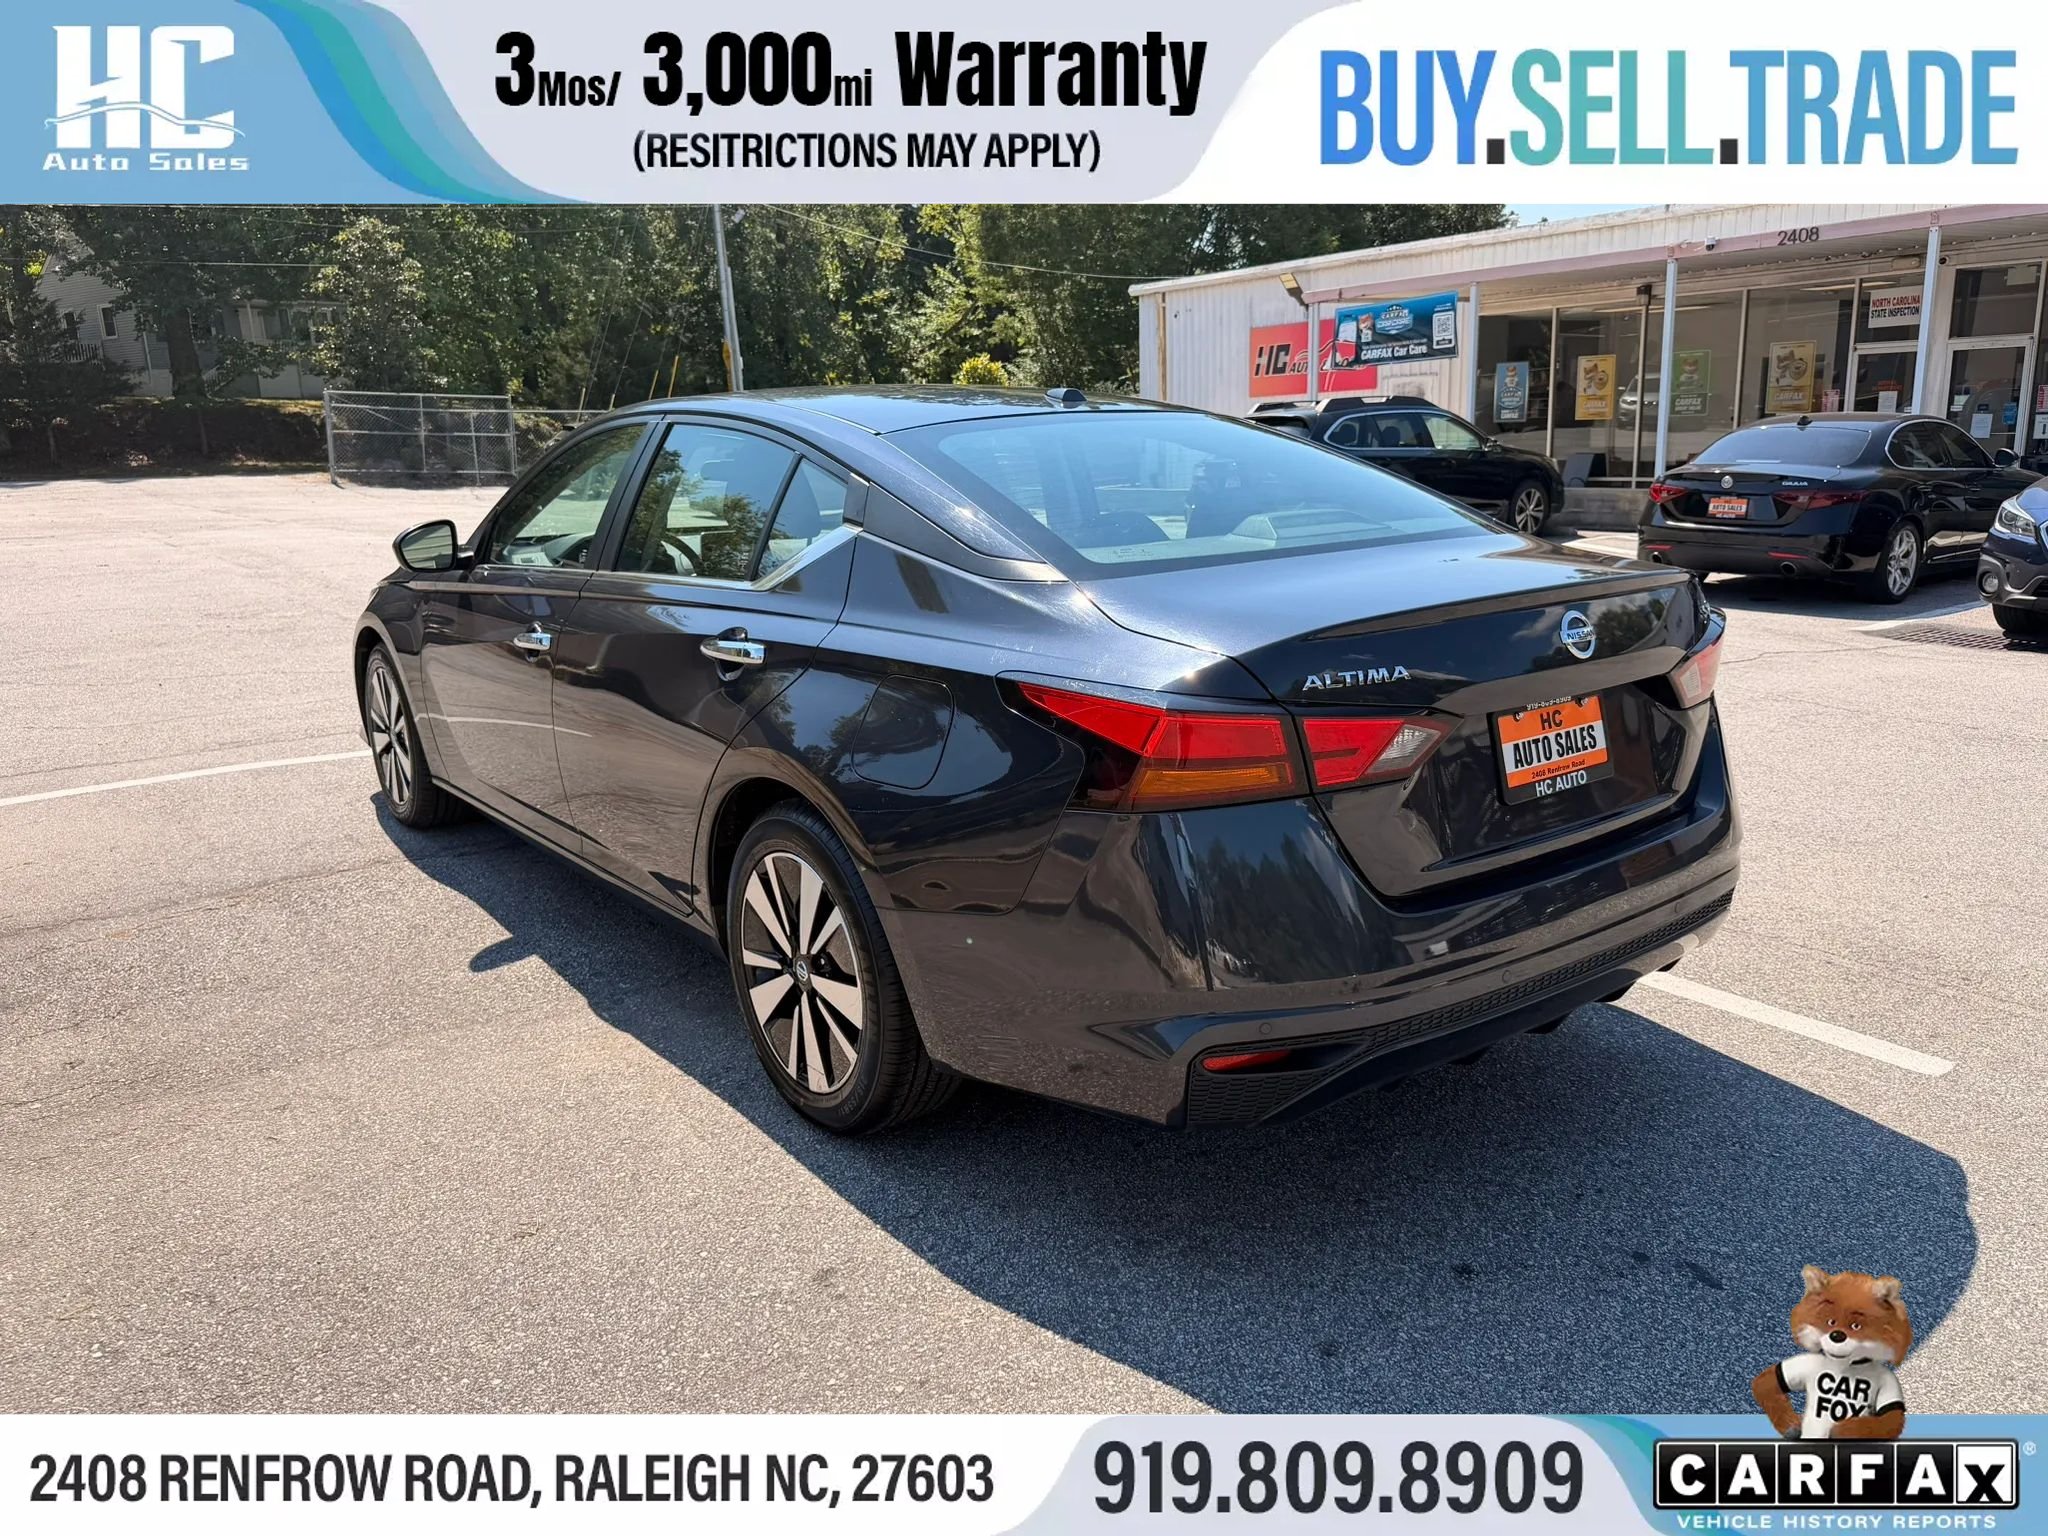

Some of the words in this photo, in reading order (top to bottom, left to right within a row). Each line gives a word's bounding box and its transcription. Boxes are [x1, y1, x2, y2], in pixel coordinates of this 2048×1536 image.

[1777, 226, 1819, 246] 2408
[1871, 297, 1891, 308] NORTH
[1892, 295, 1920, 306] CAROLINA
[1871, 308, 1887, 319] STATE
[1888, 306, 1920, 317] INSPECTION
[1254, 343, 1292, 377] HC
[1361, 348, 1392, 360] CARFAX
[1393, 346, 1408, 357] Car
[1409, 345, 1428, 355] Care
[1566, 630, 1595, 640] NISSAN
[1302, 665, 1412, 691] ALTIMA
[1540, 709, 1563, 731] HC
[1513, 735, 1553, 769] AUTO
[1555, 724, 1597, 758] SALES
[1531, 769, 1546, 779] 2408
[1547, 764, 1571, 774] Renfrow
[1571, 759, 1586, 768] Road
[1535, 780, 1553, 797] HC
[1556, 769, 1587, 792] AUTO
